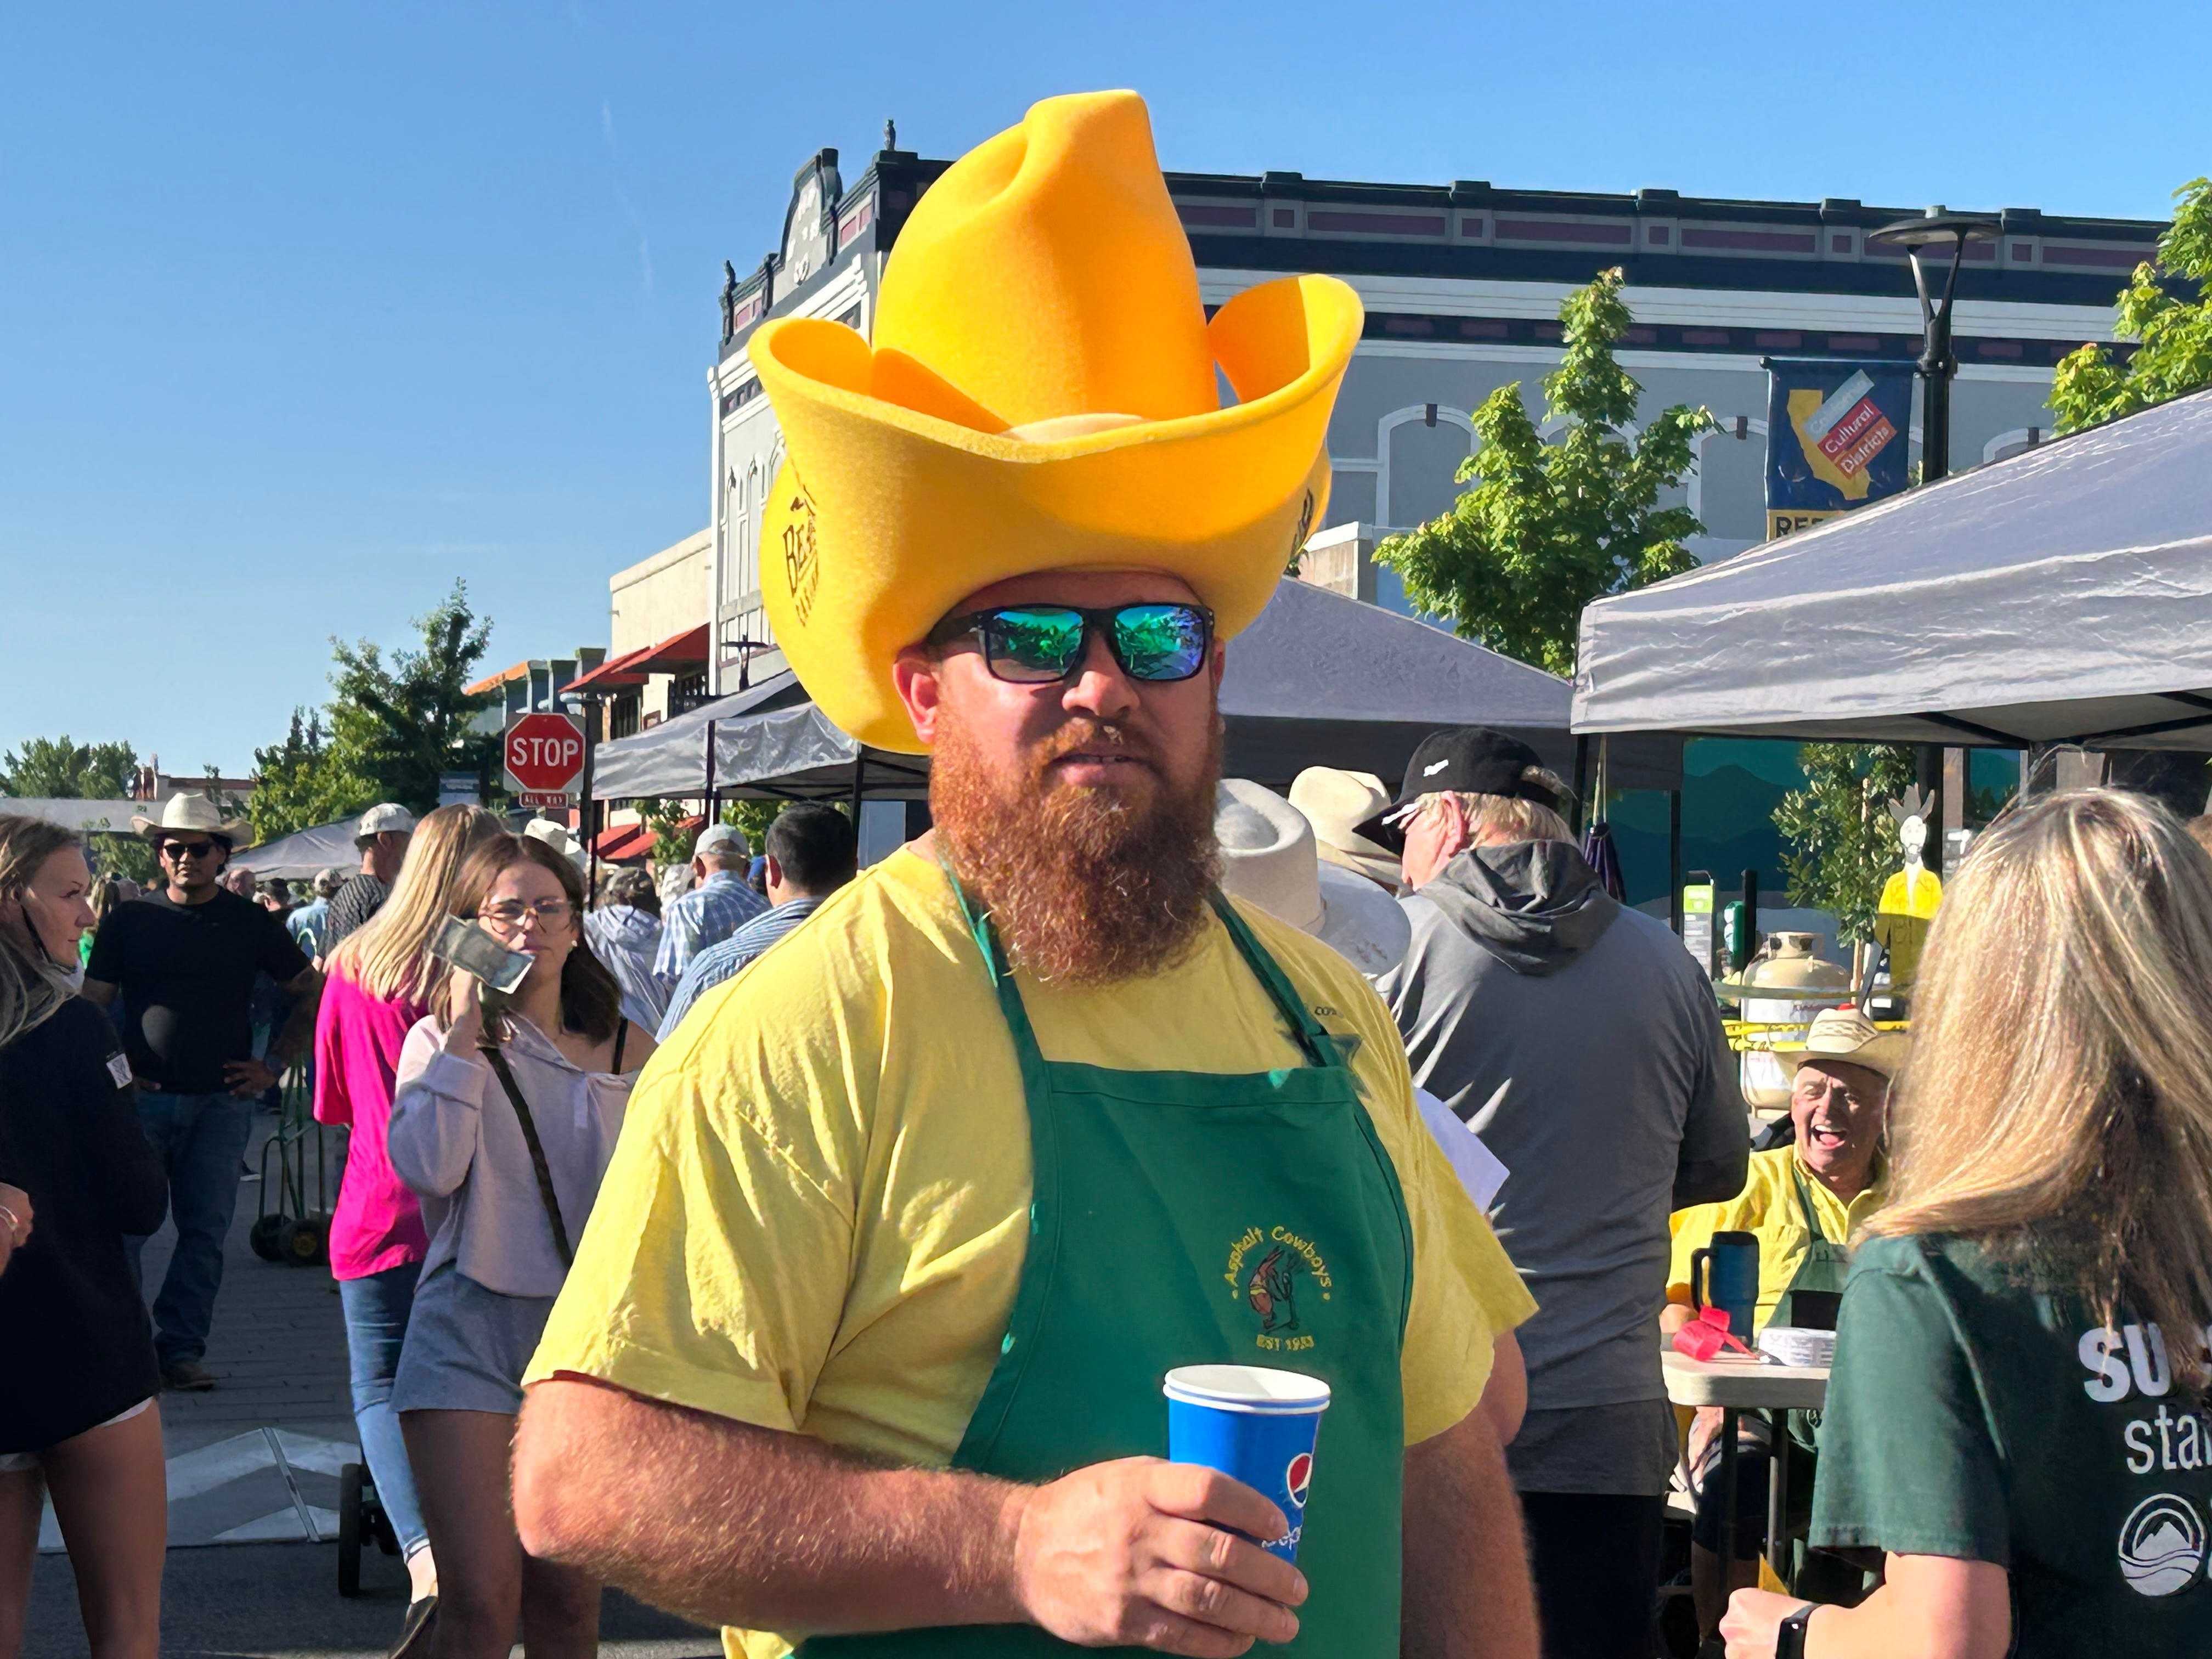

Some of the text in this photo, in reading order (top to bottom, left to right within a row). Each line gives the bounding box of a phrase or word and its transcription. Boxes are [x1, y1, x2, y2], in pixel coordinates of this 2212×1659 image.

[1825, 403, 1874, 453] Cultural
[1841, 426, 1889, 475] Districts
[1776, 516, 1824, 538] RE
[511, 737, 579, 767] STOP
[1224, 1226, 1332, 1288] Asphalt Cowboys
[1256, 1334, 1280, 1351] EST
